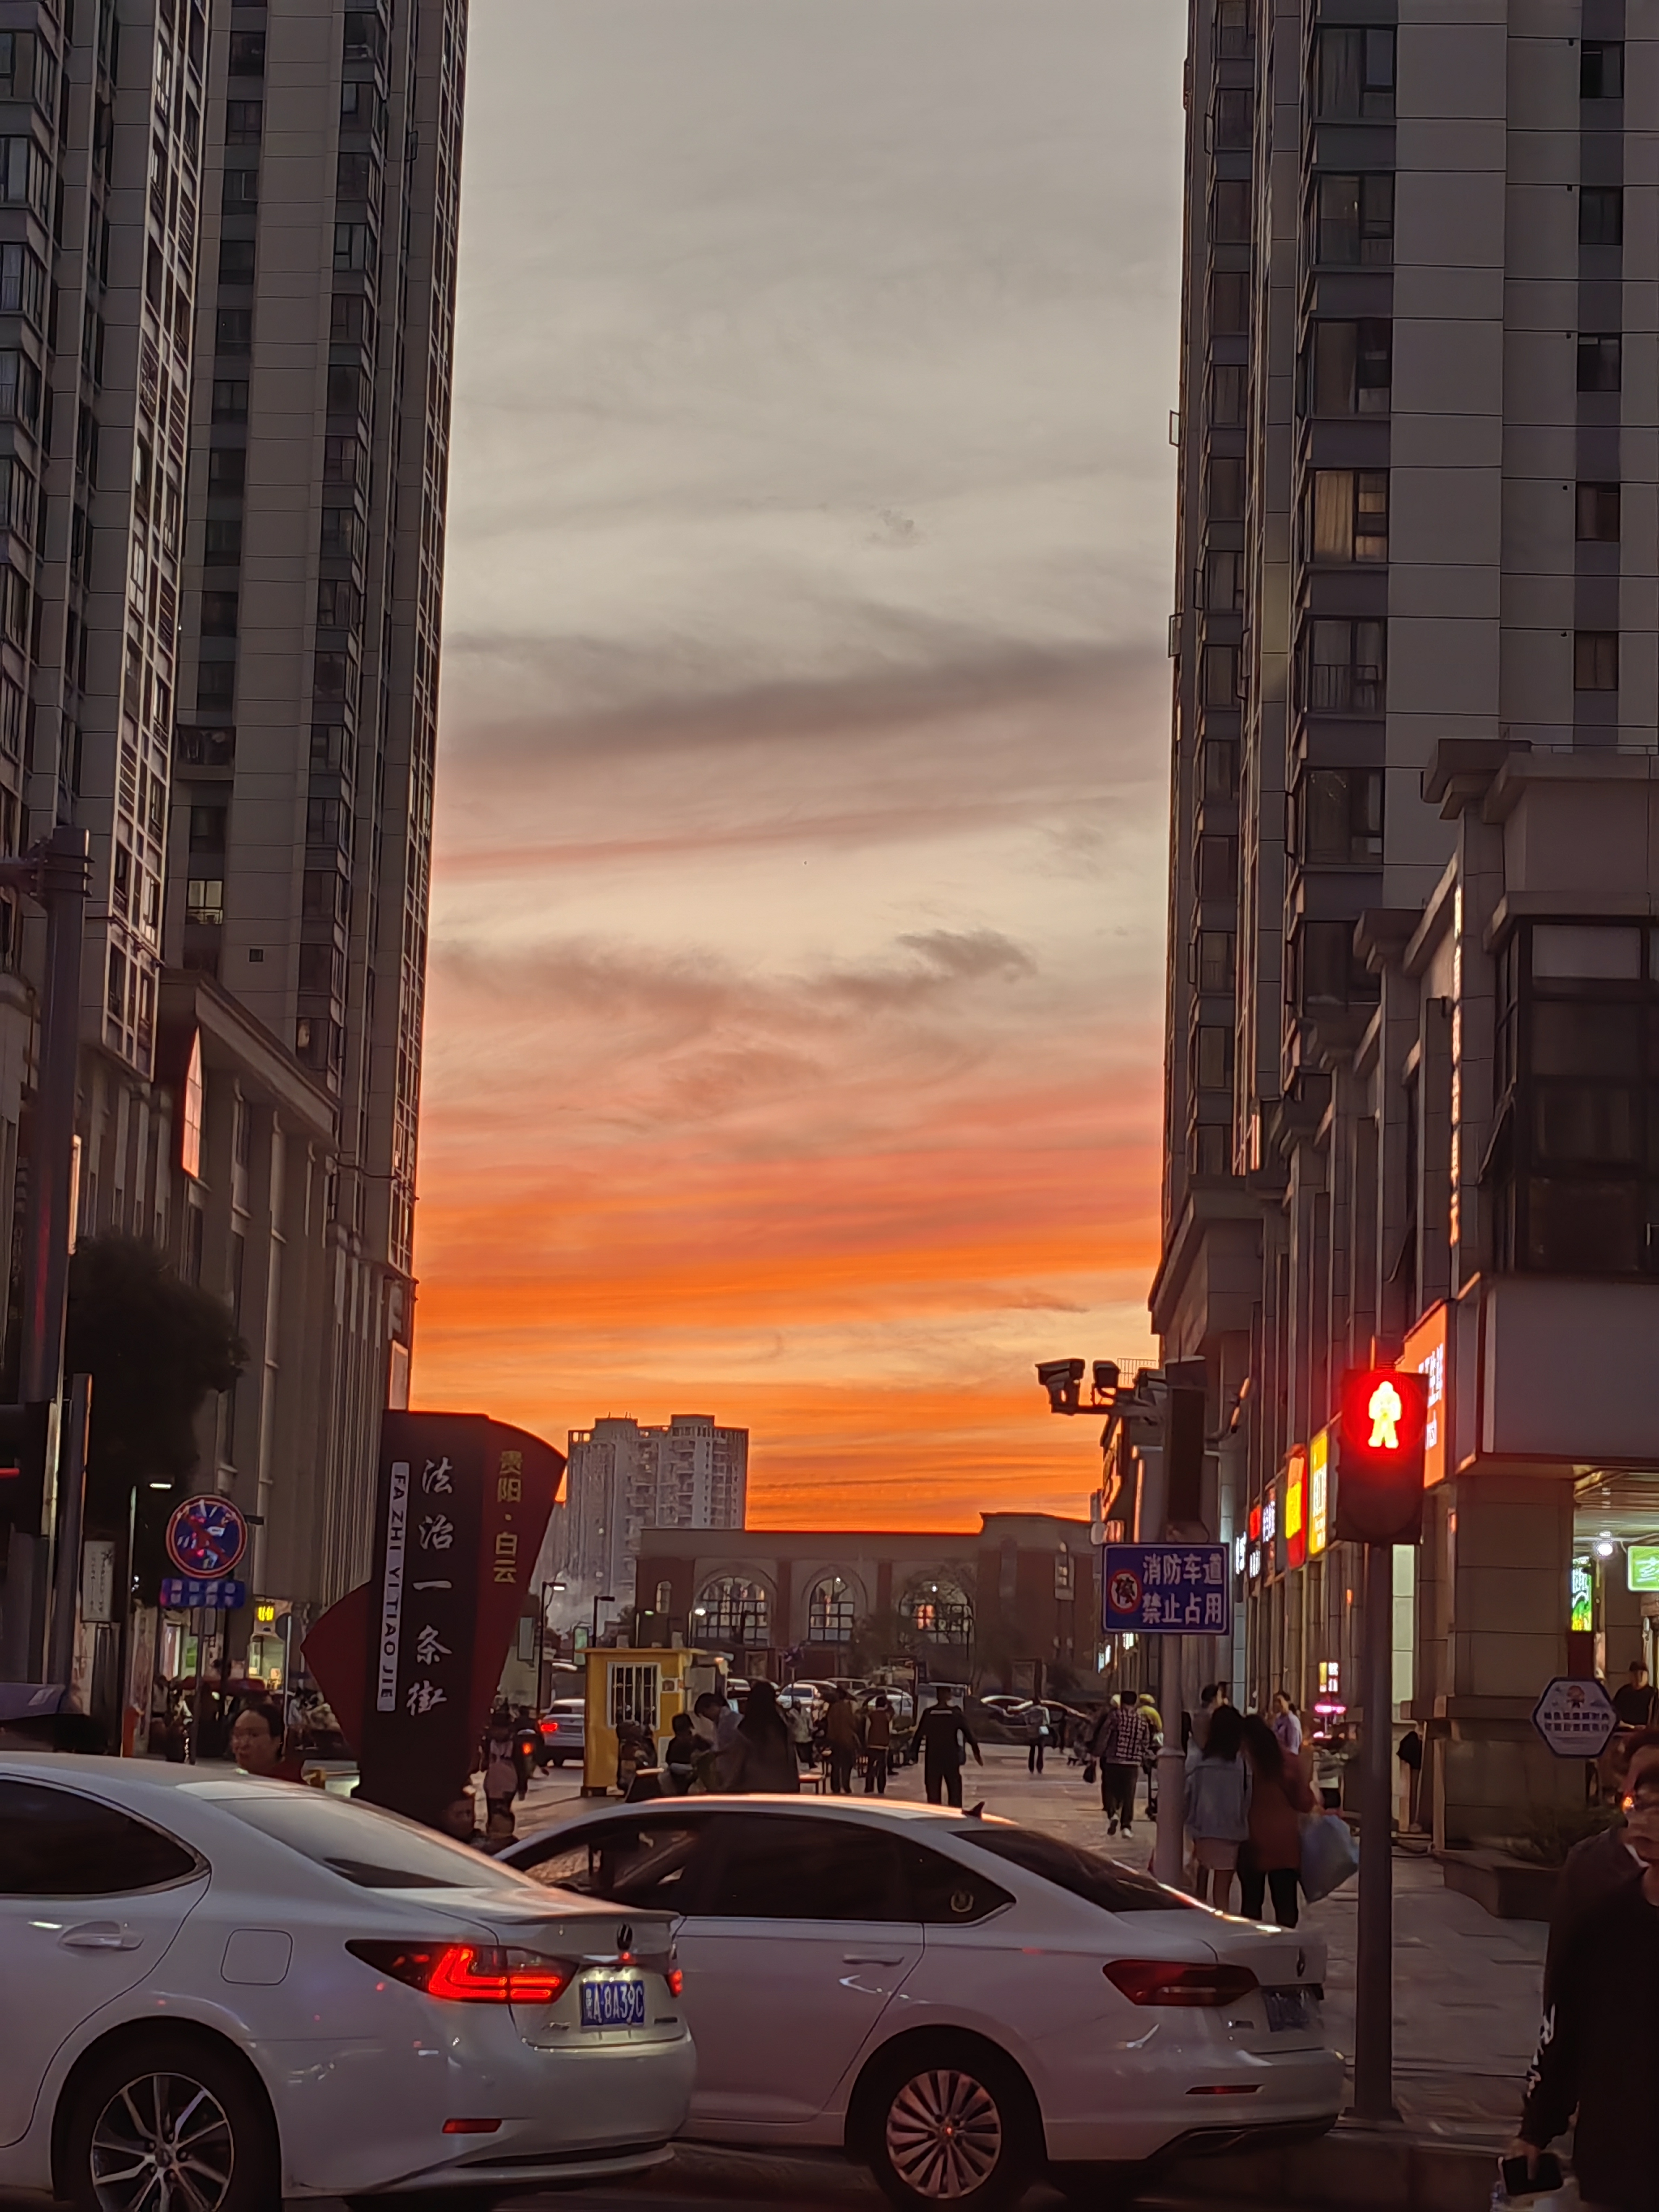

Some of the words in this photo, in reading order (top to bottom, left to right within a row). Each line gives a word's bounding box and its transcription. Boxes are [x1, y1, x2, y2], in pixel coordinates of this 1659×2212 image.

[393, 1474, 406, 1500] FA
[389, 1512, 403, 1550] ZHI
[1142, 1553, 1223, 1585] 消防车道
[407, 1456, 454, 1716] 法治一条街
[1142, 1592, 1222, 1625] 禁止占用
[380, 1665, 394, 1698] JIE
